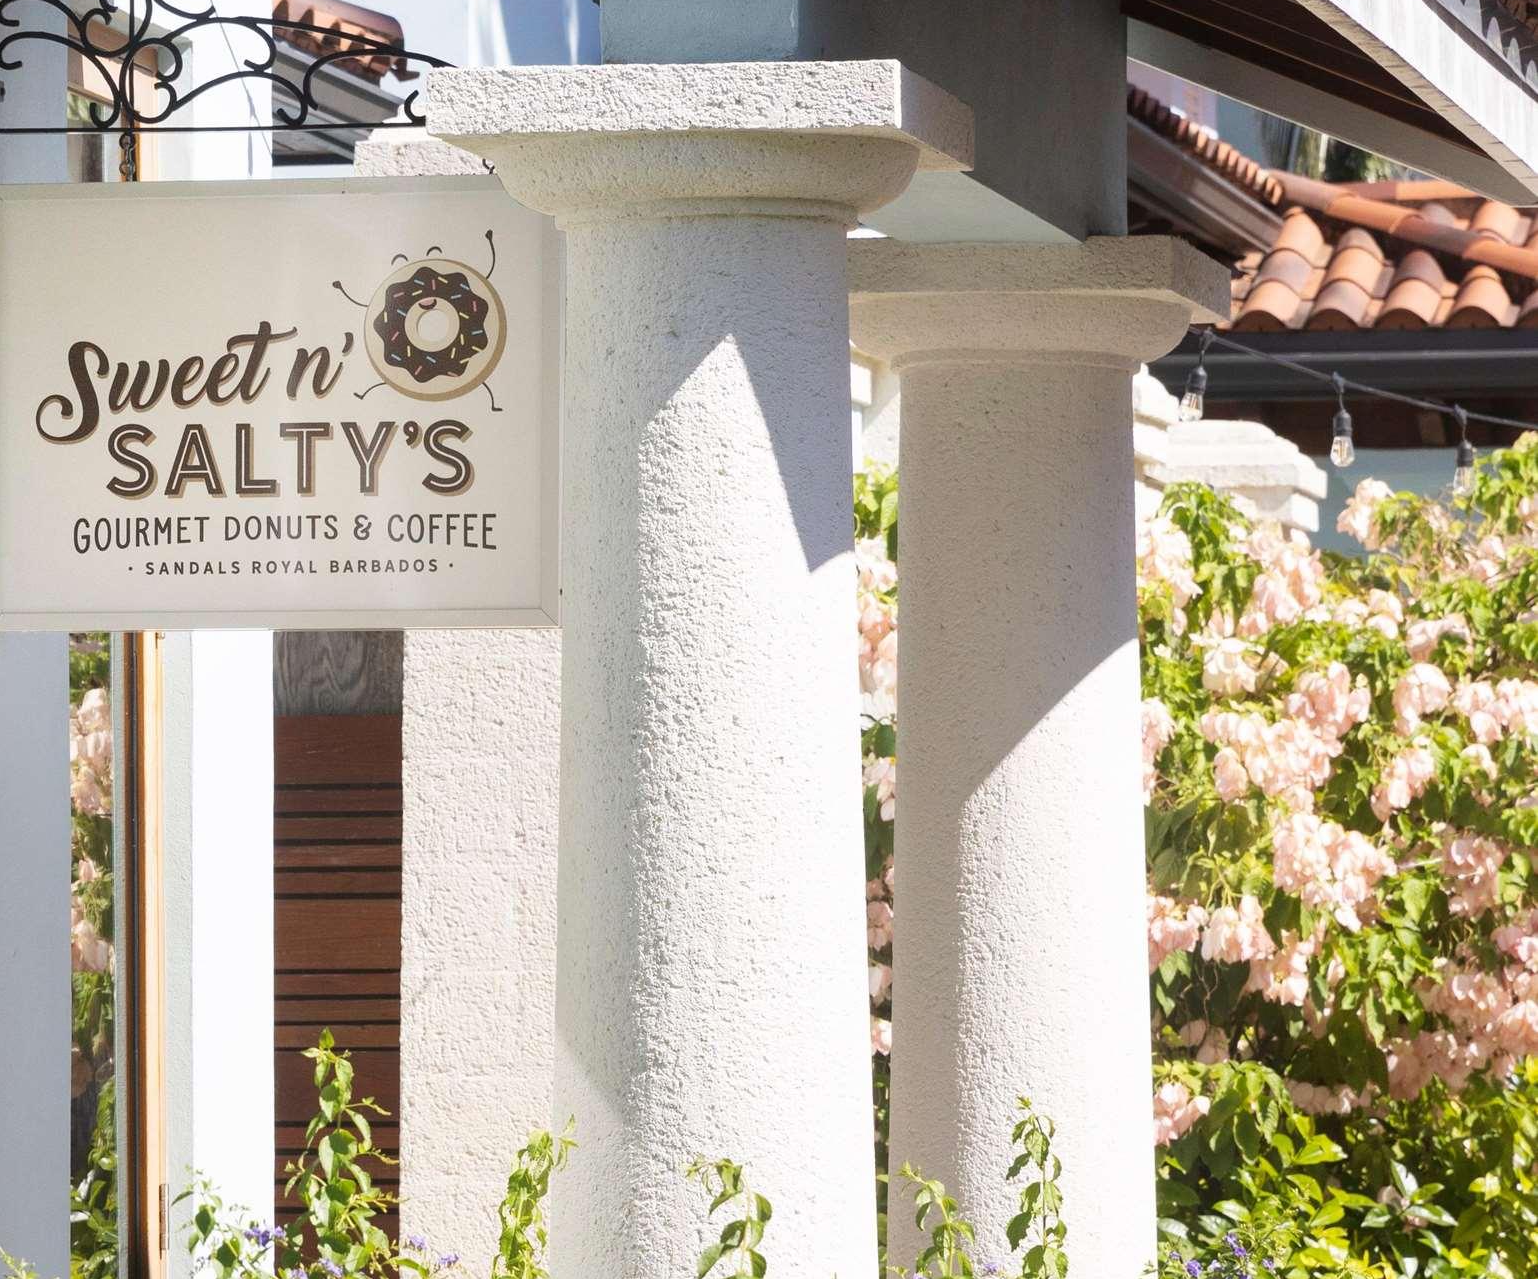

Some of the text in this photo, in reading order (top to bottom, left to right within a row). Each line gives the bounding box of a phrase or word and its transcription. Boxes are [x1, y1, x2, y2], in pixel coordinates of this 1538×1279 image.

[35, 320, 355, 443] Sweet n'
[106, 418, 476, 499] SALTY'S
[73, 513, 498, 555] GOURMET DONUTS & COFFEE
[145, 558, 438, 576] SANDALS ROYAL BARBADOS
